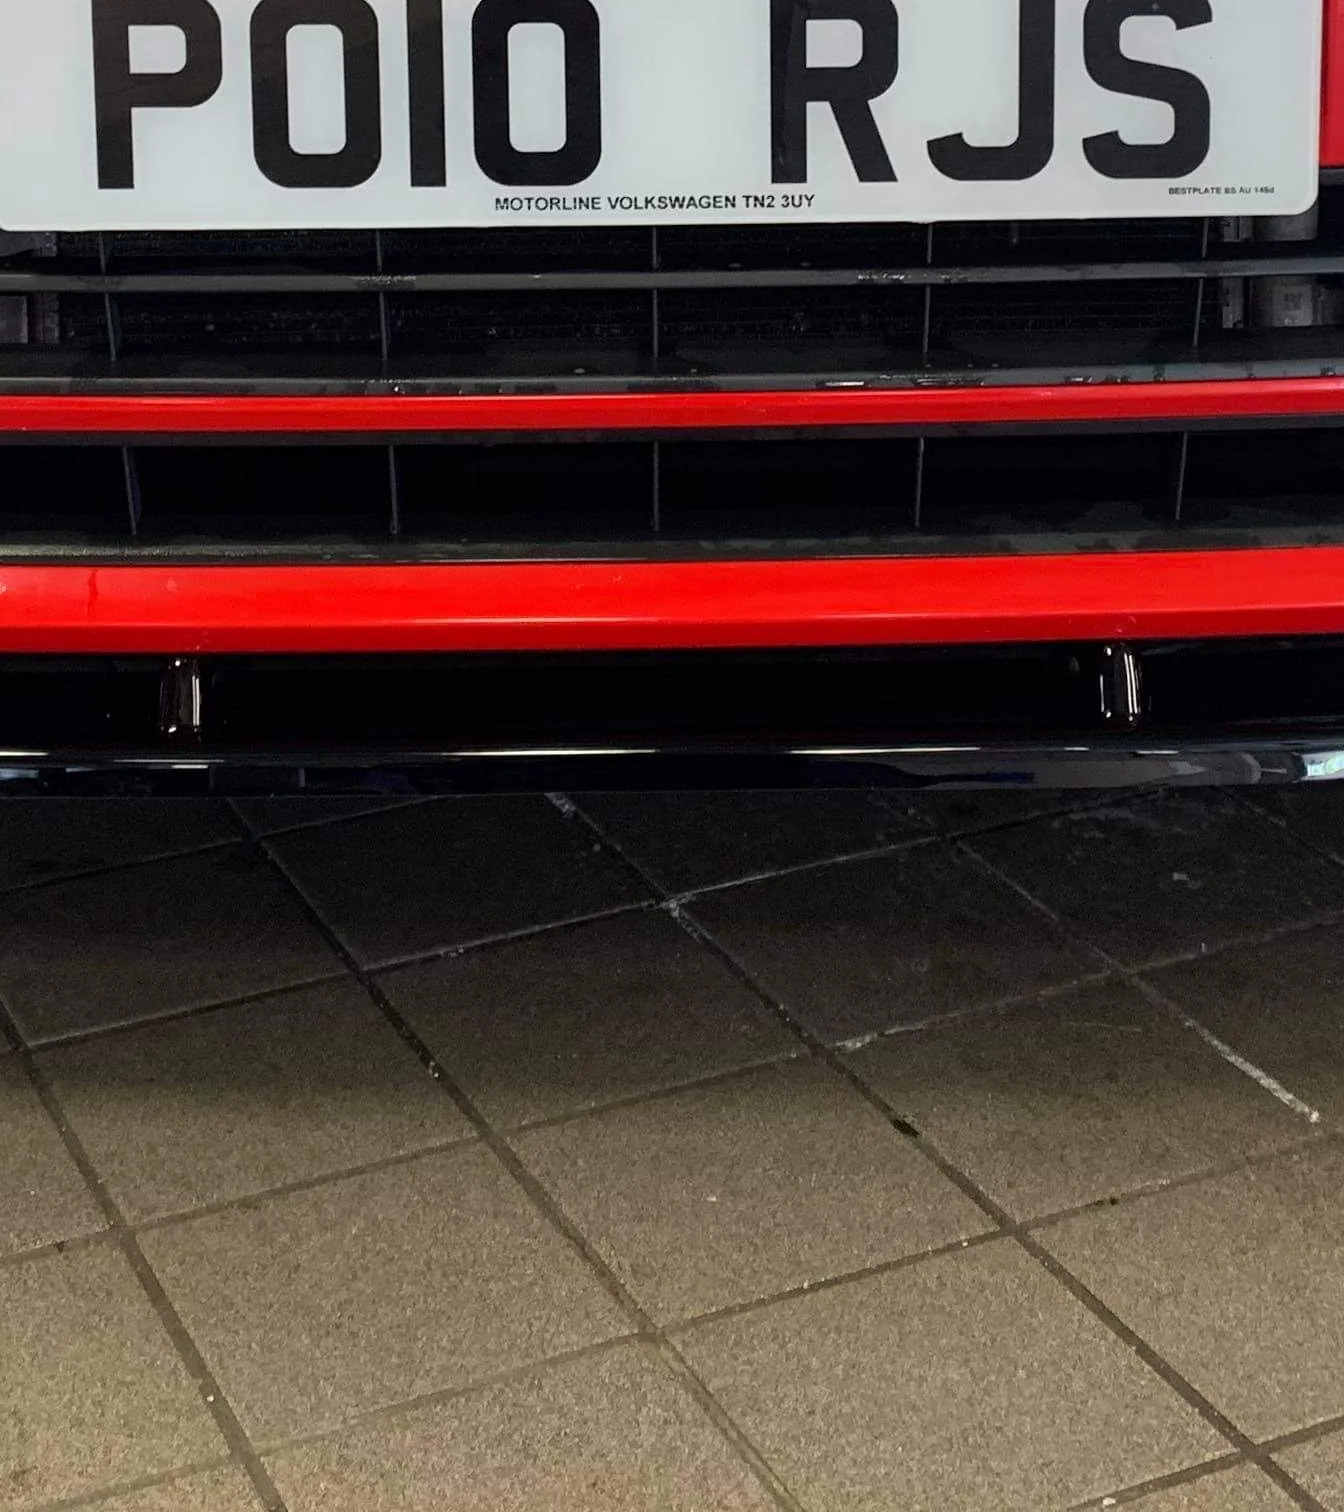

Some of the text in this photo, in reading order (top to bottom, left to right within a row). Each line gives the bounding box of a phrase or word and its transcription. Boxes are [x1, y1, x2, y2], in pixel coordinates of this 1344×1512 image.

[1239, 186, 1251, 194] AU
[495, 193, 815, 211] MOTORLINE VOLKSWAGEN TN2 3UY
